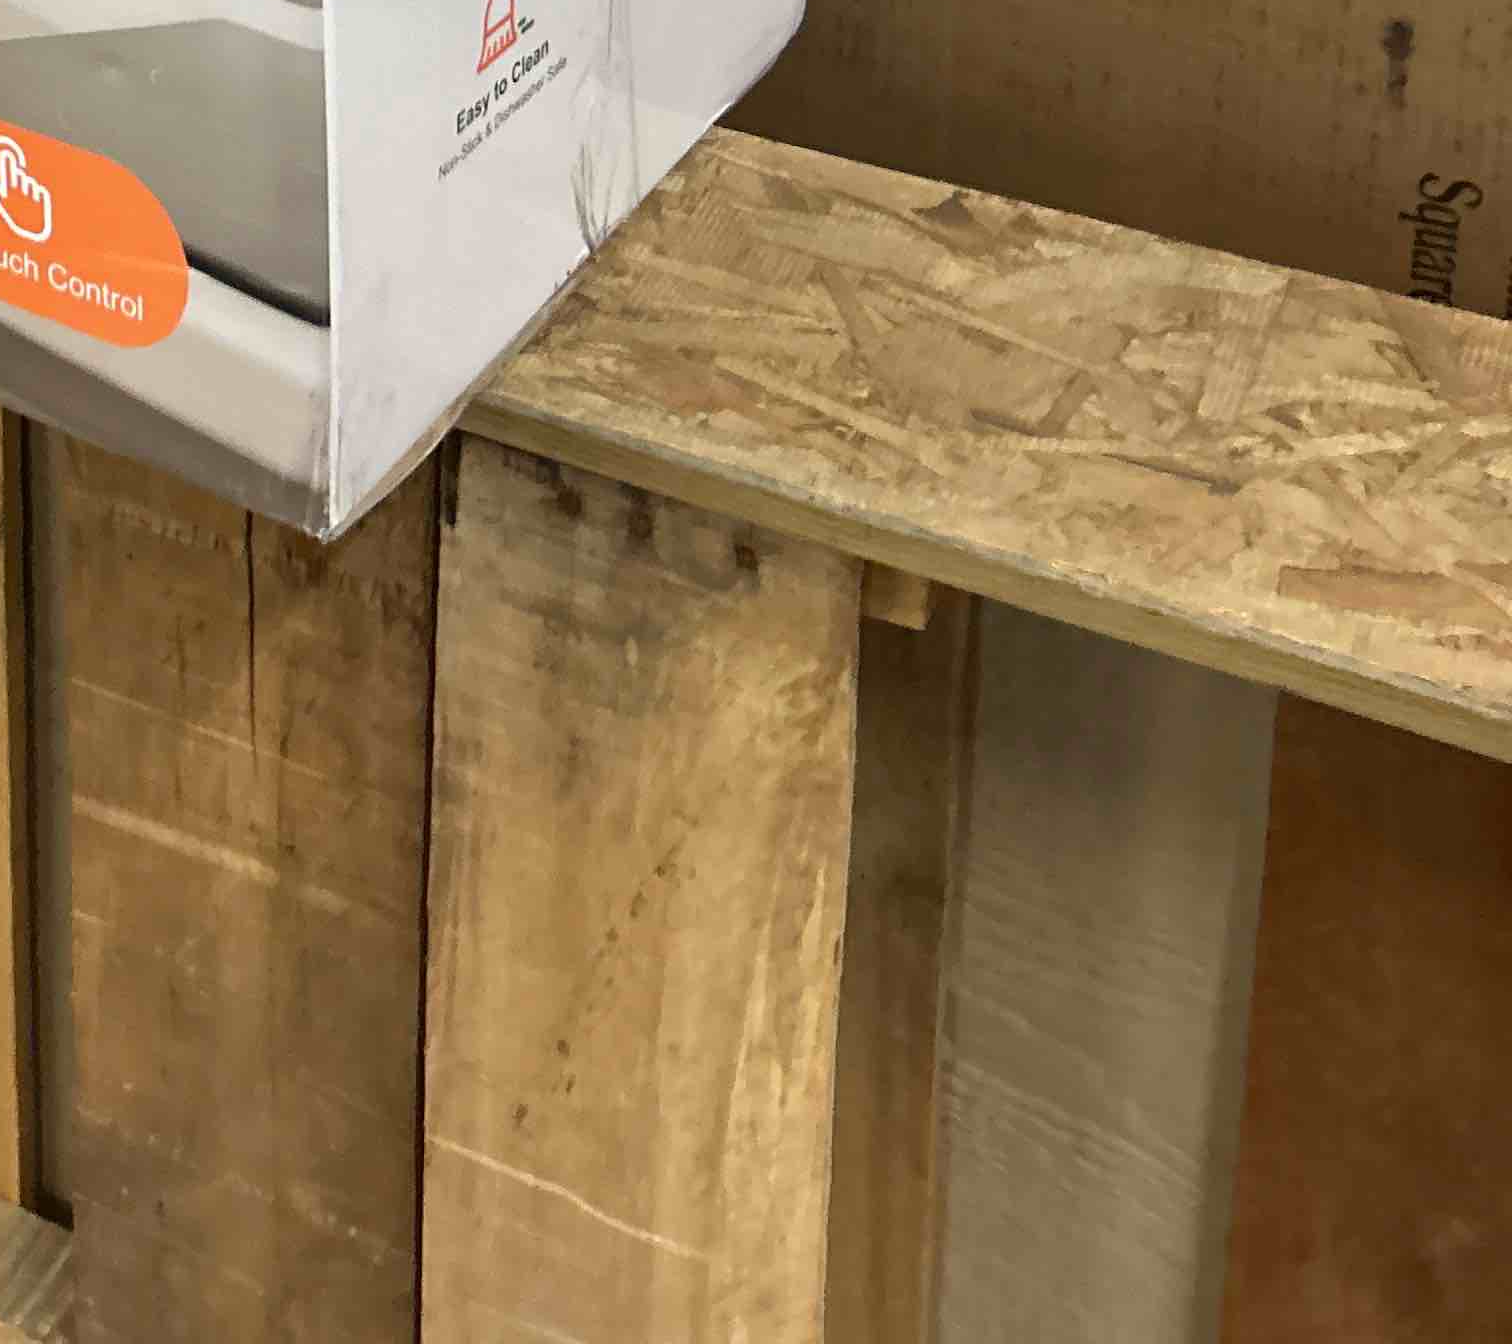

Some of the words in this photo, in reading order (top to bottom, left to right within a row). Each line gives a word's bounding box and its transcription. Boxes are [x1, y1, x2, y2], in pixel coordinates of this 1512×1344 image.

[456, 93, 490, 135] Easy
[494, 78, 507, 101] to
[511, 40, 549, 83] Clean
[47, 263, 143, 321] Control
